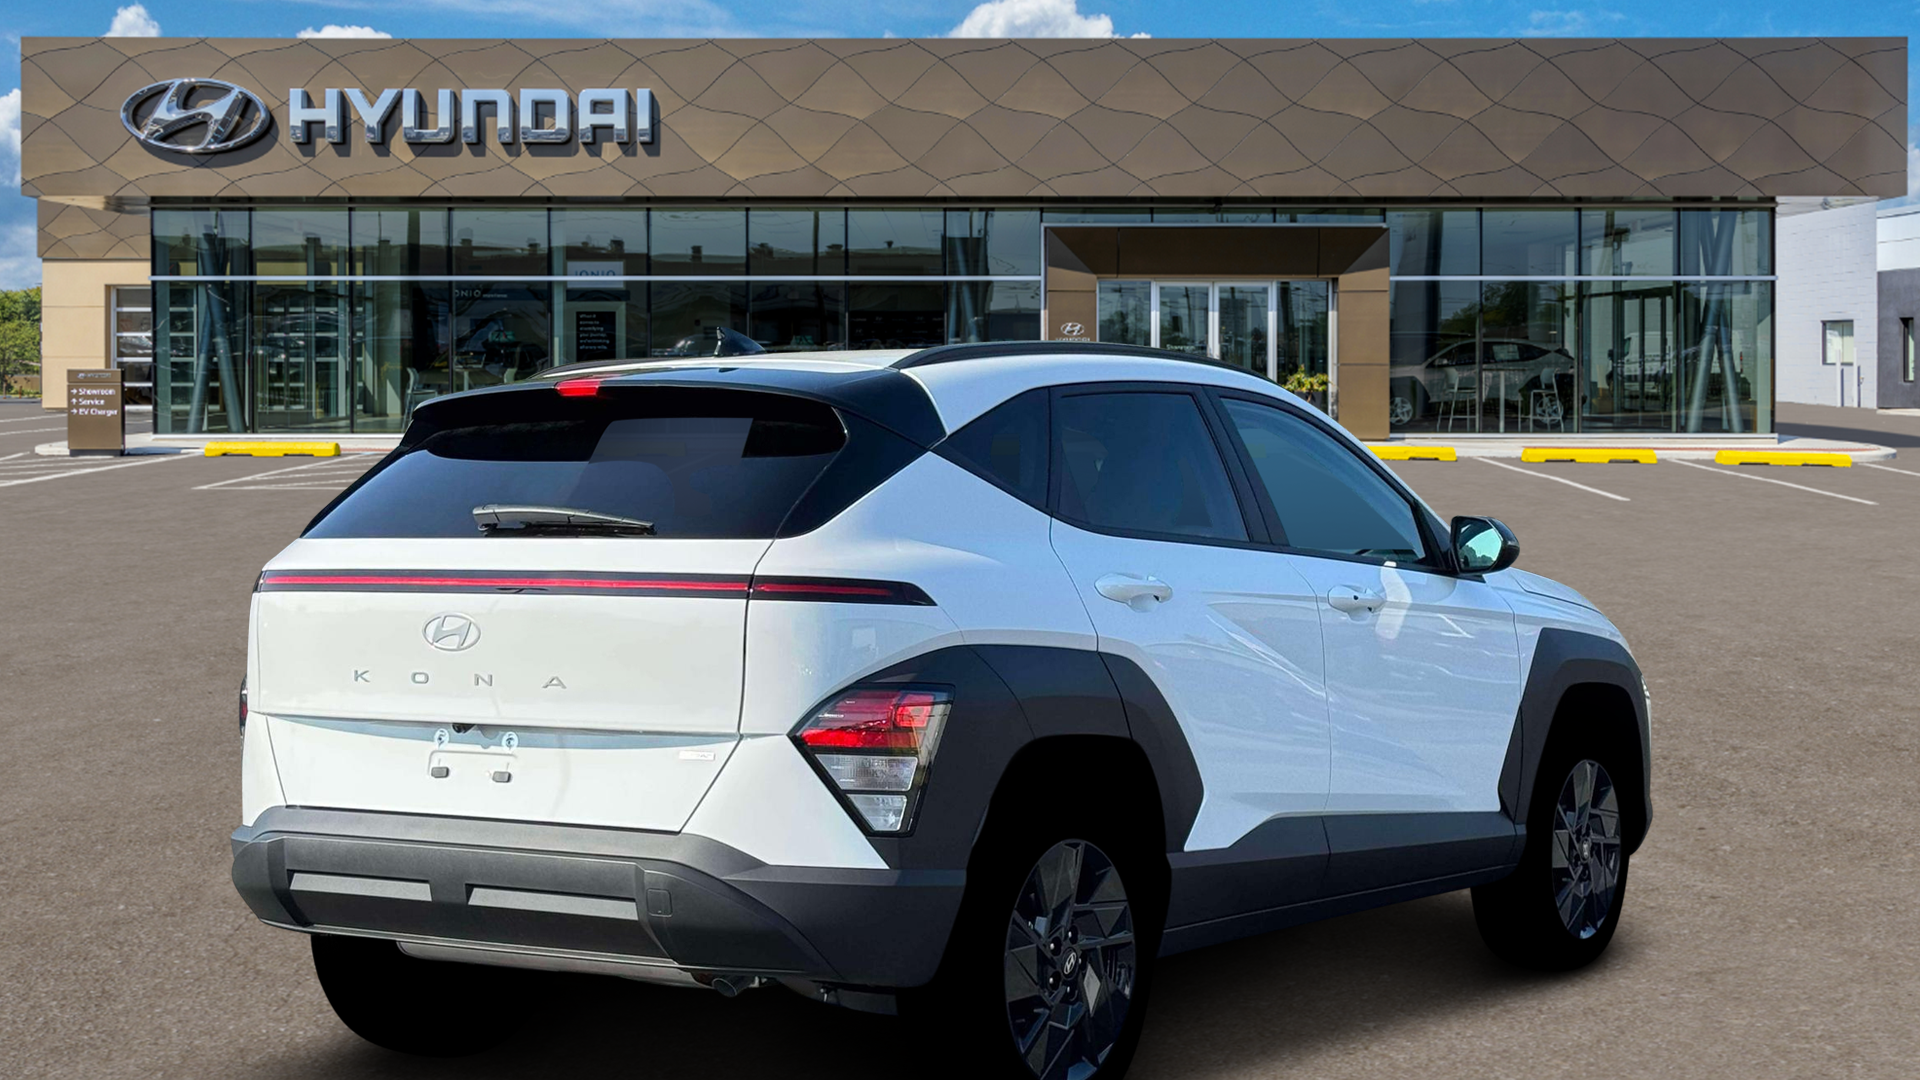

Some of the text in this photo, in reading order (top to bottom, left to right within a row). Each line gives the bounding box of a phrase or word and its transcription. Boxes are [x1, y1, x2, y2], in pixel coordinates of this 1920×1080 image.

[289, 87, 654, 144] HYUNDAI
[79, 388, 116, 396] Showroom
[79, 398, 105, 406] Service
[90, 408, 118, 417] Charger
[353, 668, 568, 690] KONA
